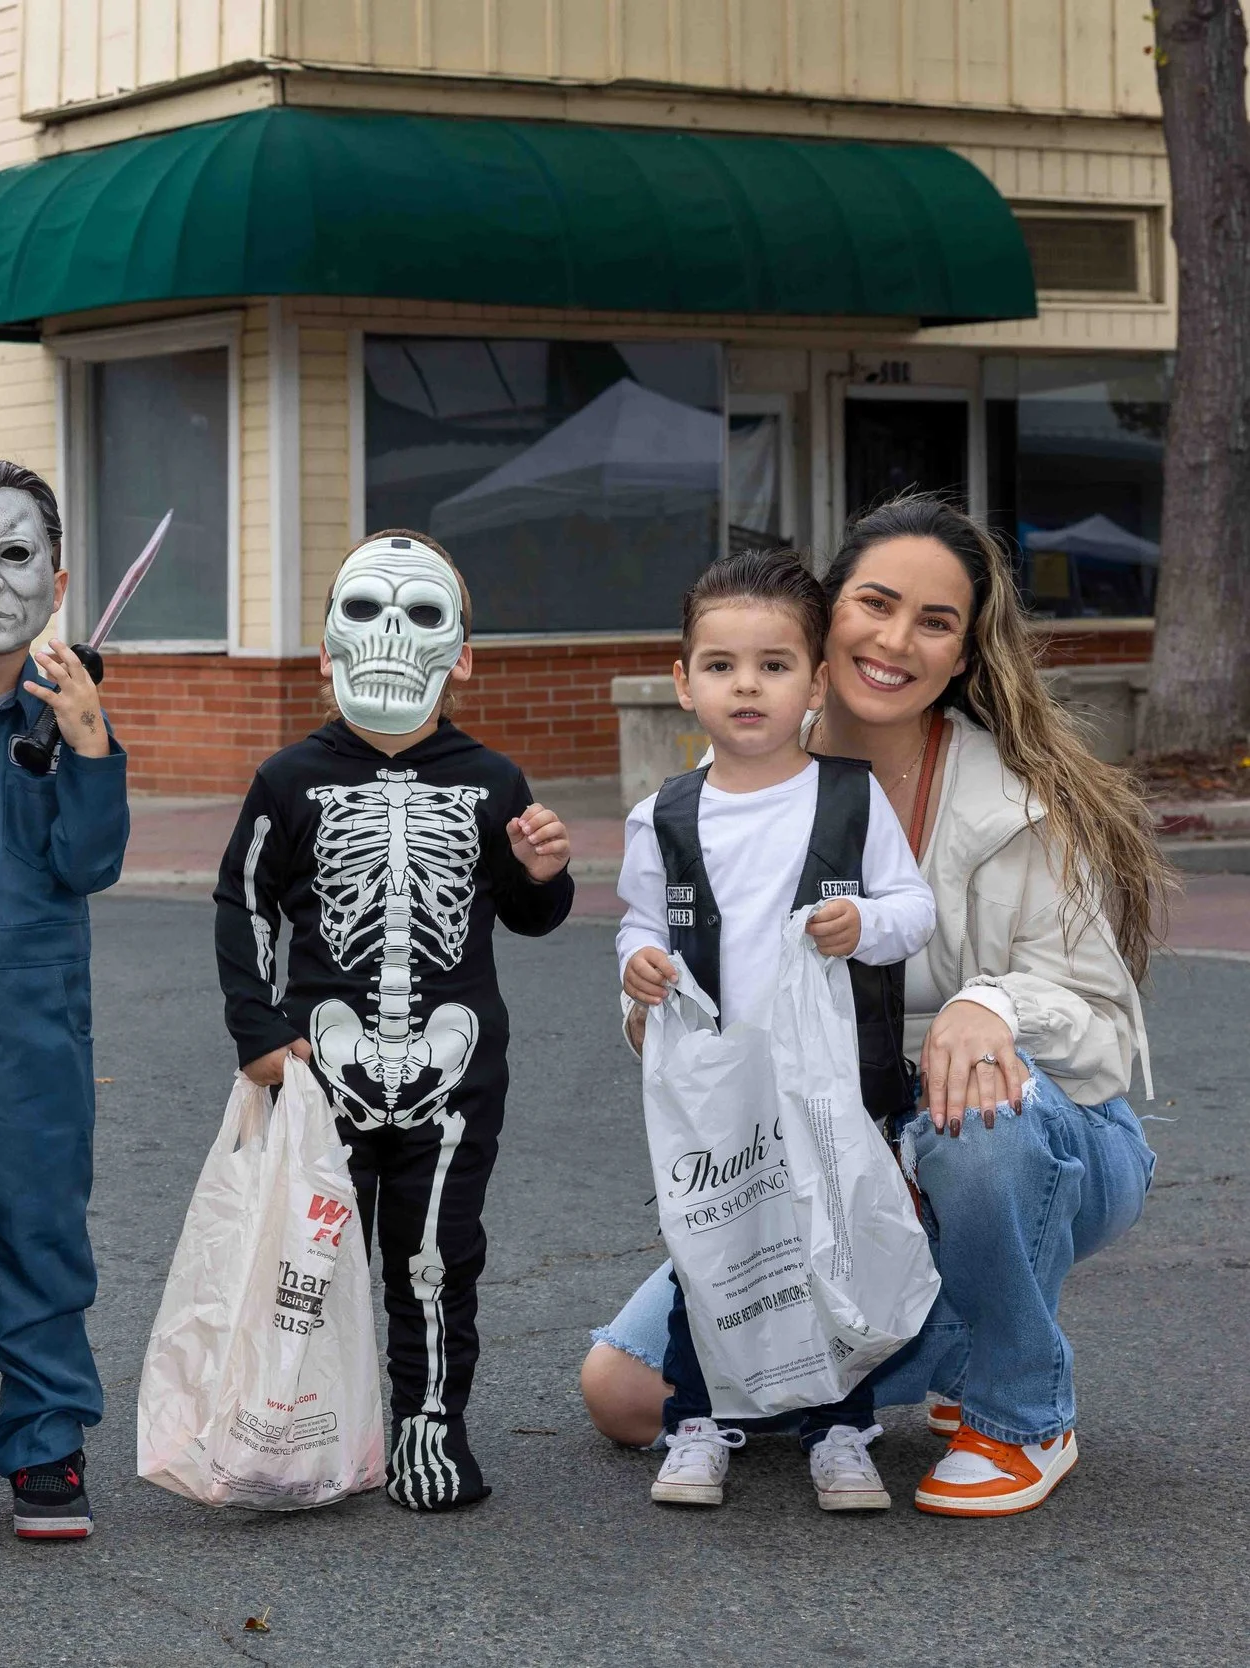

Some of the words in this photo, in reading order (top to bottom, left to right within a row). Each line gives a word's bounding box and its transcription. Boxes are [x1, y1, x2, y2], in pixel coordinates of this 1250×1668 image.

[823, 881, 859, 897] REDWOOD
[668, 1123, 770, 1198] Thank
[685, 1206, 720, 1229] FOR
[721, 1172, 785, 1218] SHOPPING
[316, 1250, 337, 1262] Employ
[727, 1263, 740, 1273] This
[761, 1245, 776, 1254] bag
[280, 1291, 311, 1311] Using
[725, 1290, 738, 1300] This
[738, 1286, 749, 1295] bag
[716, 1311, 742, 1331] PLEASE
[741, 1298, 765, 1323] RETURN
[761, 1295, 773, 1310] TO
[260, 1445, 269, 1454] OR
